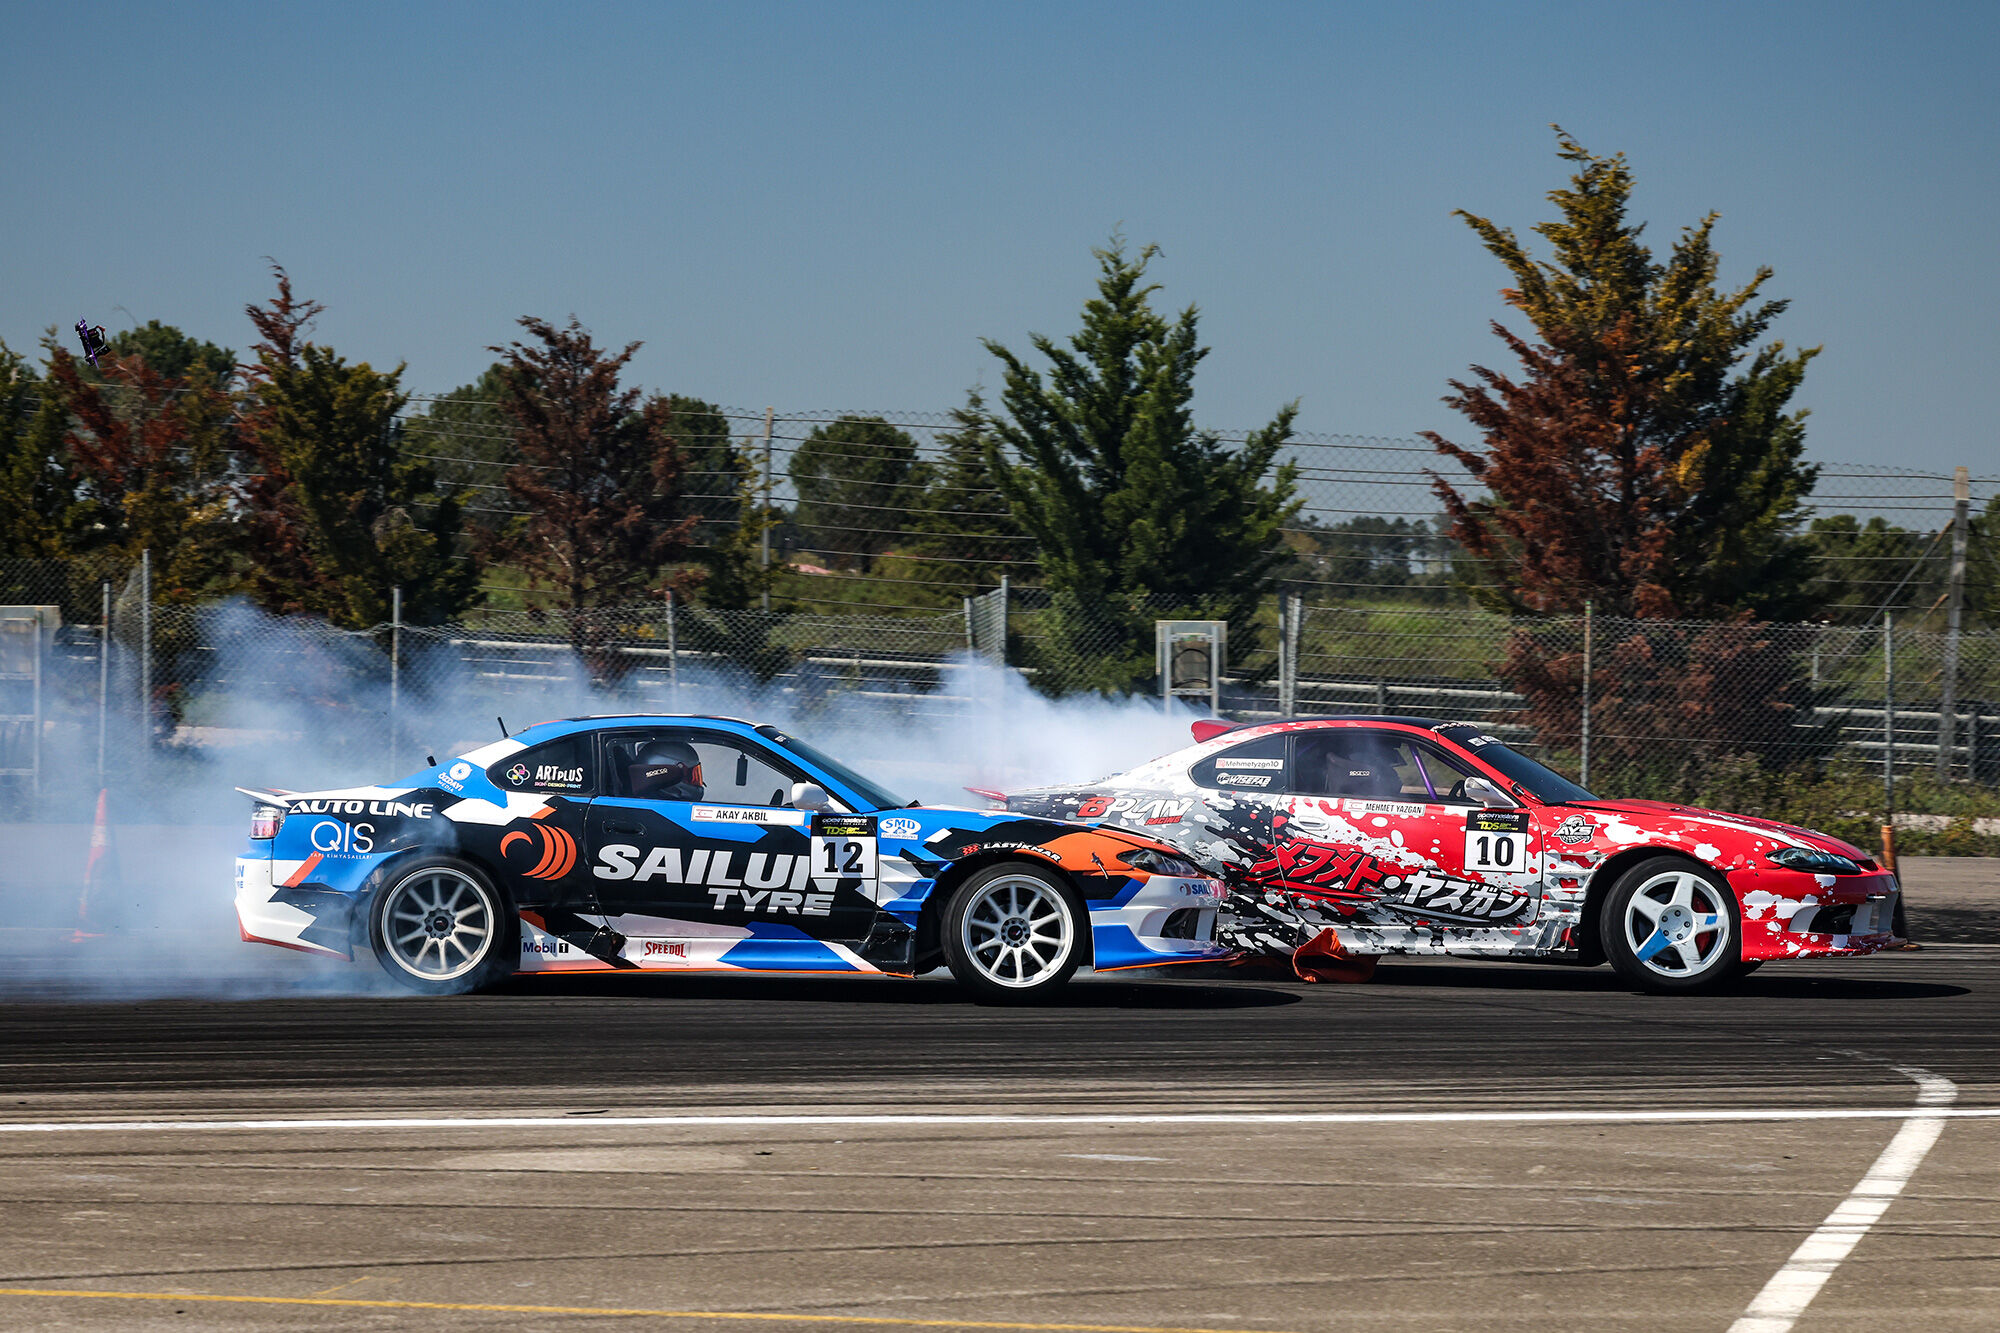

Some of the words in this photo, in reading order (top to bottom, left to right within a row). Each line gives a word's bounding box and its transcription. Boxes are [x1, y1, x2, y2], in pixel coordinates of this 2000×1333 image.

[1230, 774, 1272, 787] WISEFAB
[288, 800, 365, 814] AUTO
[369, 801, 434, 819] LINE
[715, 810, 740, 820] AKAY
[1076, 797, 1197, 820] BPLAN
[1365, 803, 1395, 812] MEHMET
[1396, 805, 1422, 814] YAZGAN
[885, 819, 915, 829] SMD
[1144, 815, 1183, 826] RACING
[311, 821, 375, 853] QIS
[823, 842, 863, 873] 12
[1477, 836, 1514, 866] 10
[708, 889, 835, 916] TYRE
[523, 942, 557, 953] Mobil
[559, 943, 569, 953] 1
[645, 941, 687, 958] SPEEDOL
